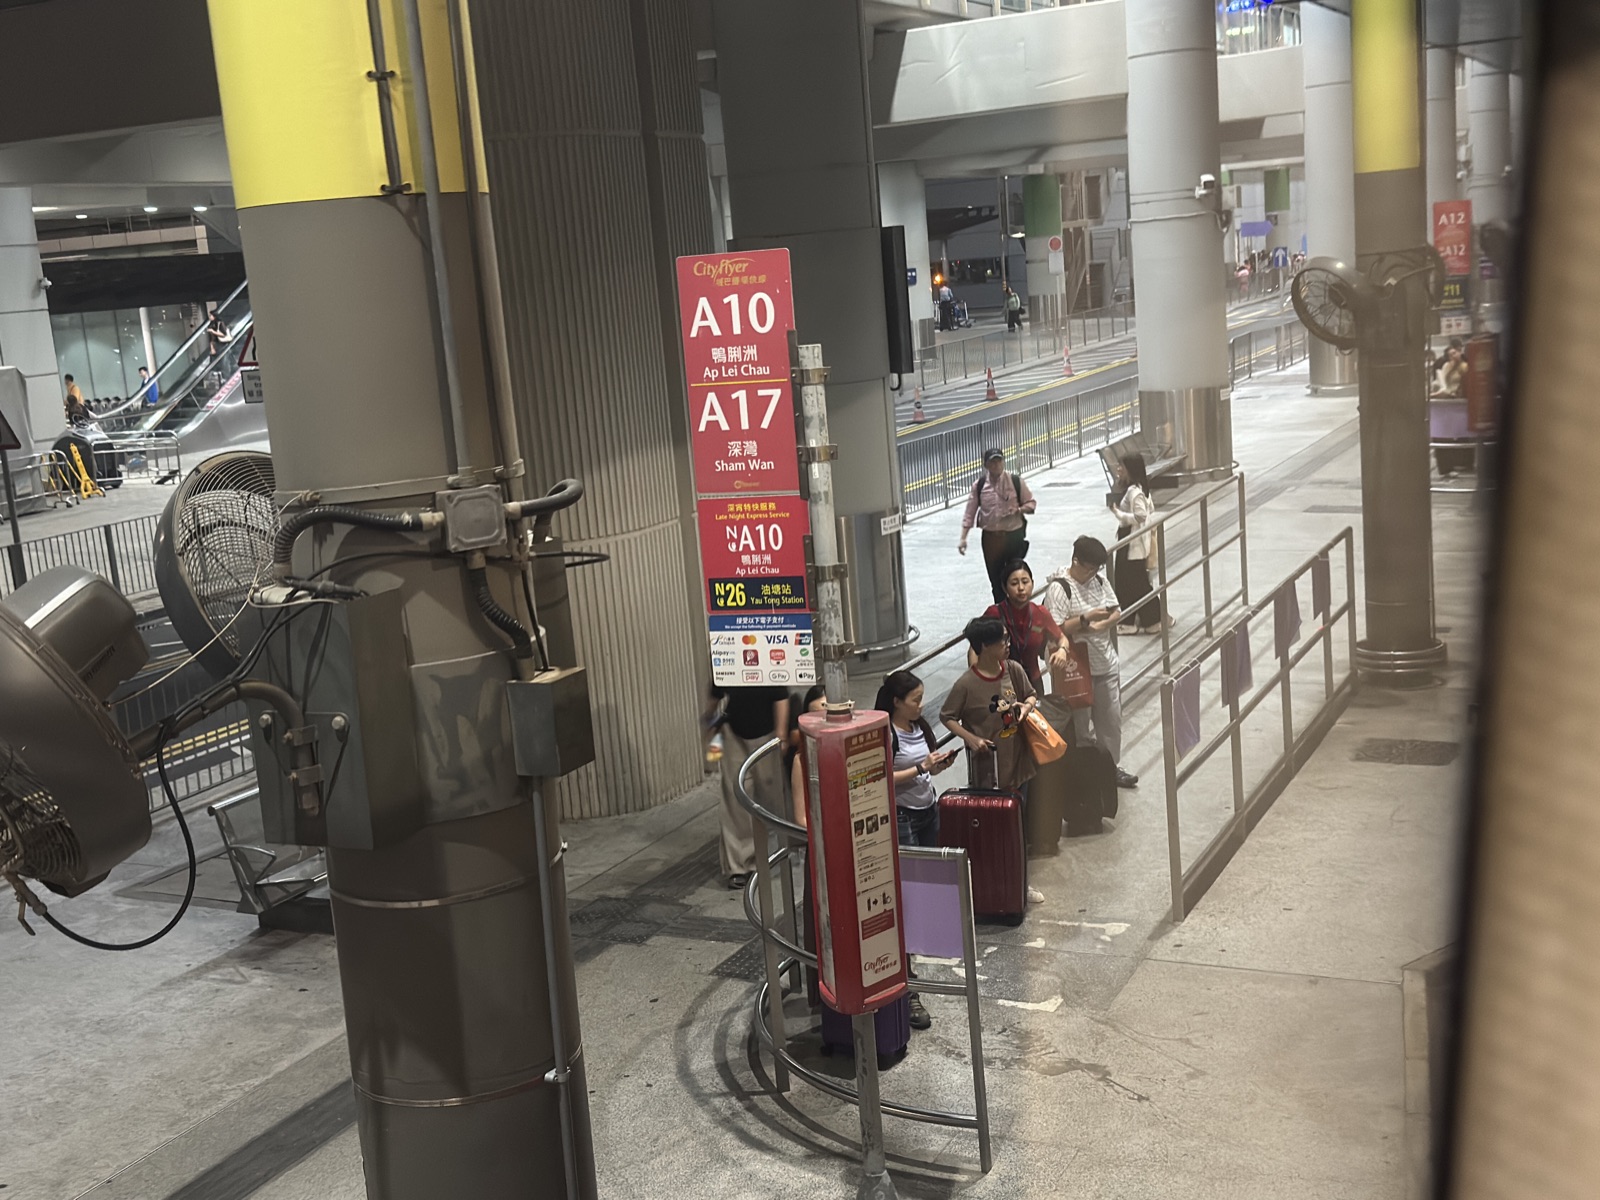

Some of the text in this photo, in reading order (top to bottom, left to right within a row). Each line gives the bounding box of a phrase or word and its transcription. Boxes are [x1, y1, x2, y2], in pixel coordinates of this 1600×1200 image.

[1438, 212, 1466, 225] A12
[690, 292, 775, 338] A10
[711, 344, 758, 364] 鴨脷洲
[703, 364, 770, 381] Ap Lei Chau
[698, 389, 782, 432] A17
[728, 440, 758, 457] 深灣
[715, 459, 775, 472] Sham Wan
[729, 512, 745, 521] Night
[746, 512, 768, 520] Express
[735, 566, 780, 577] Ap Lei Chau
[715, 582, 746, 607] N26
[761, 583, 792, 595] 油塘站
[764, 596, 780, 606] Tong
[781, 595, 804, 604] Station
[765, 635, 789, 644] VISA
